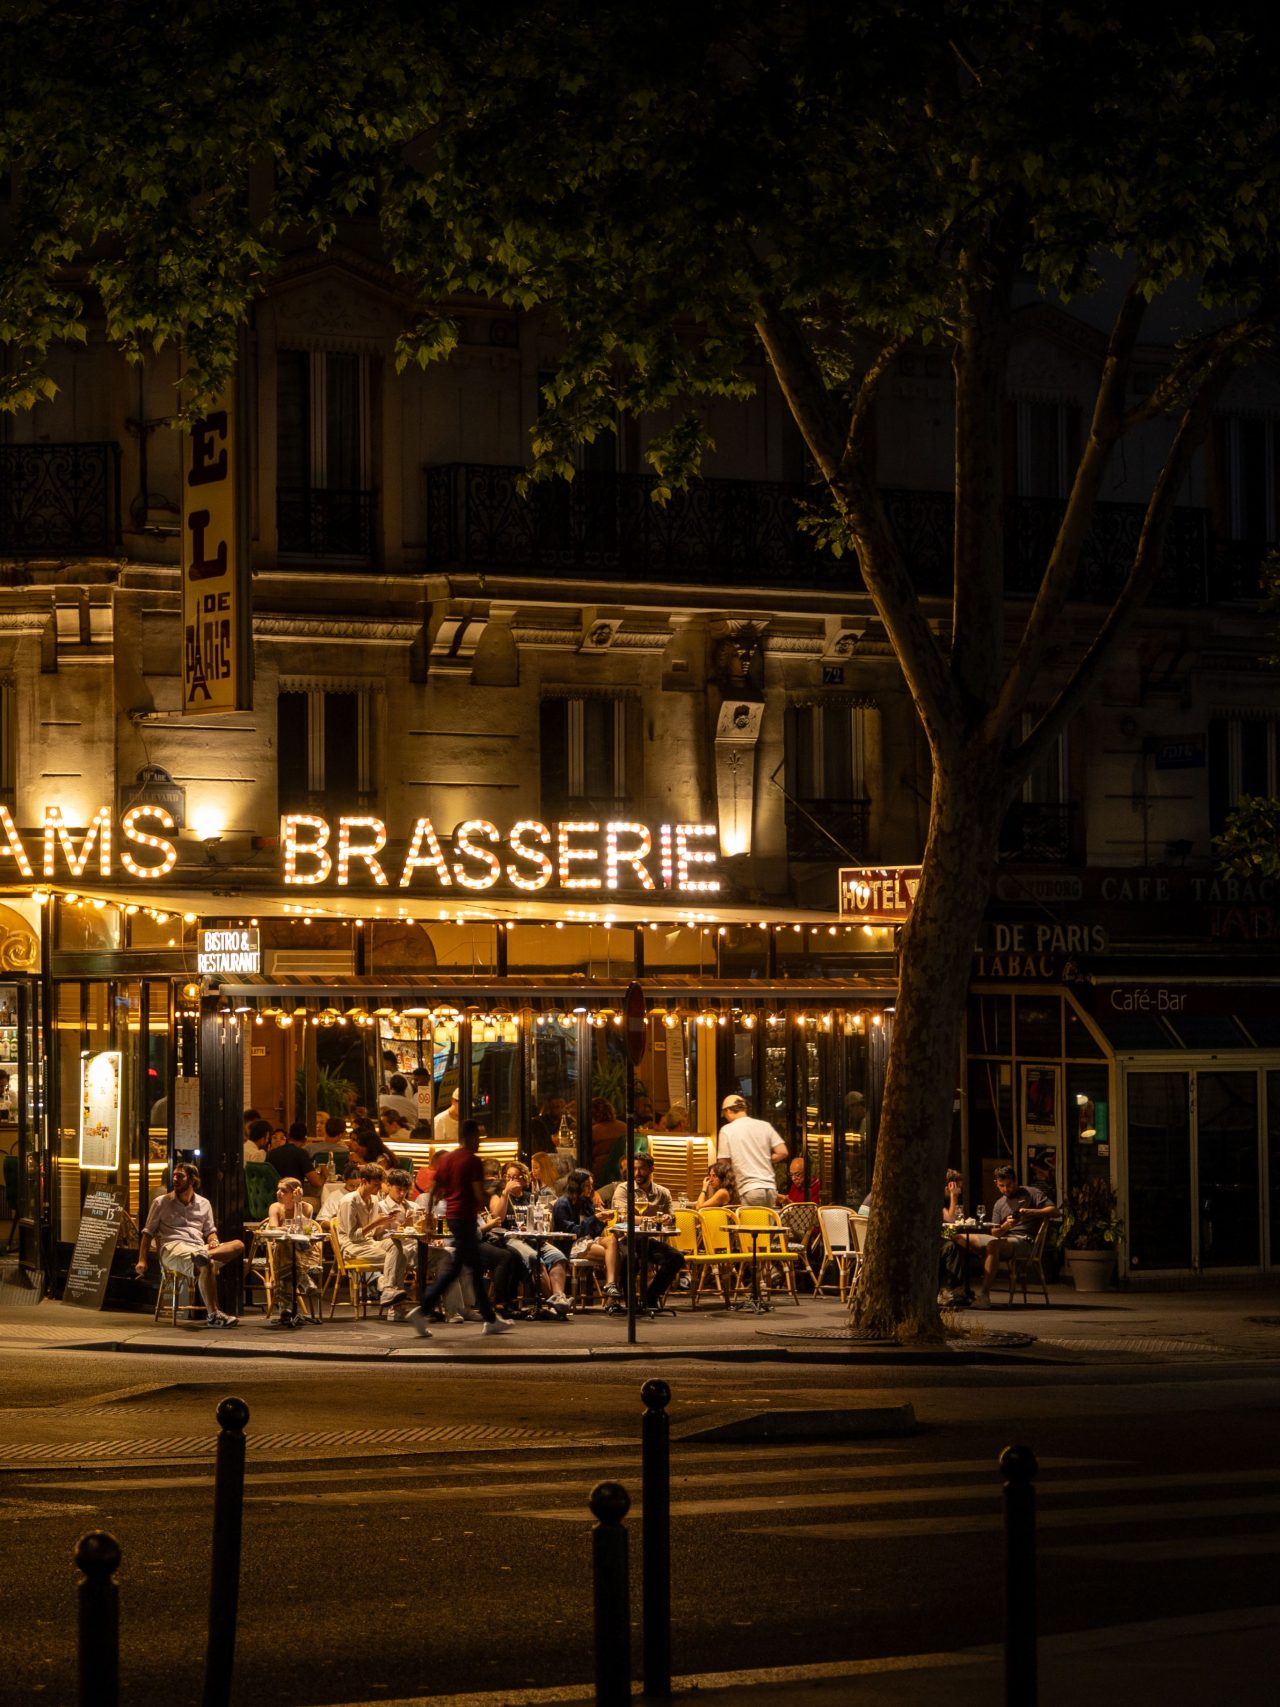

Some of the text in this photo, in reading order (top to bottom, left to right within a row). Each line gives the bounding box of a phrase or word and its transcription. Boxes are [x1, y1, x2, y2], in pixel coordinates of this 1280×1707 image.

[203, 592, 231, 613] DE
[824, 667, 842, 683] 72
[279, 813, 720, 892] BRASSERIE
[841, 878, 907, 911] HOTEL
[1190, 876, 1276, 903] TABAC
[1206, 905, 1280, 940] TAB
[203, 931, 250, 952] BISTRO &
[995, 923, 1025, 953] DE
[1036, 922, 1106, 954] PARIS
[197, 952, 260, 973] RESTAURANT
[1110, 988, 1188, 1012] Café-Bar
